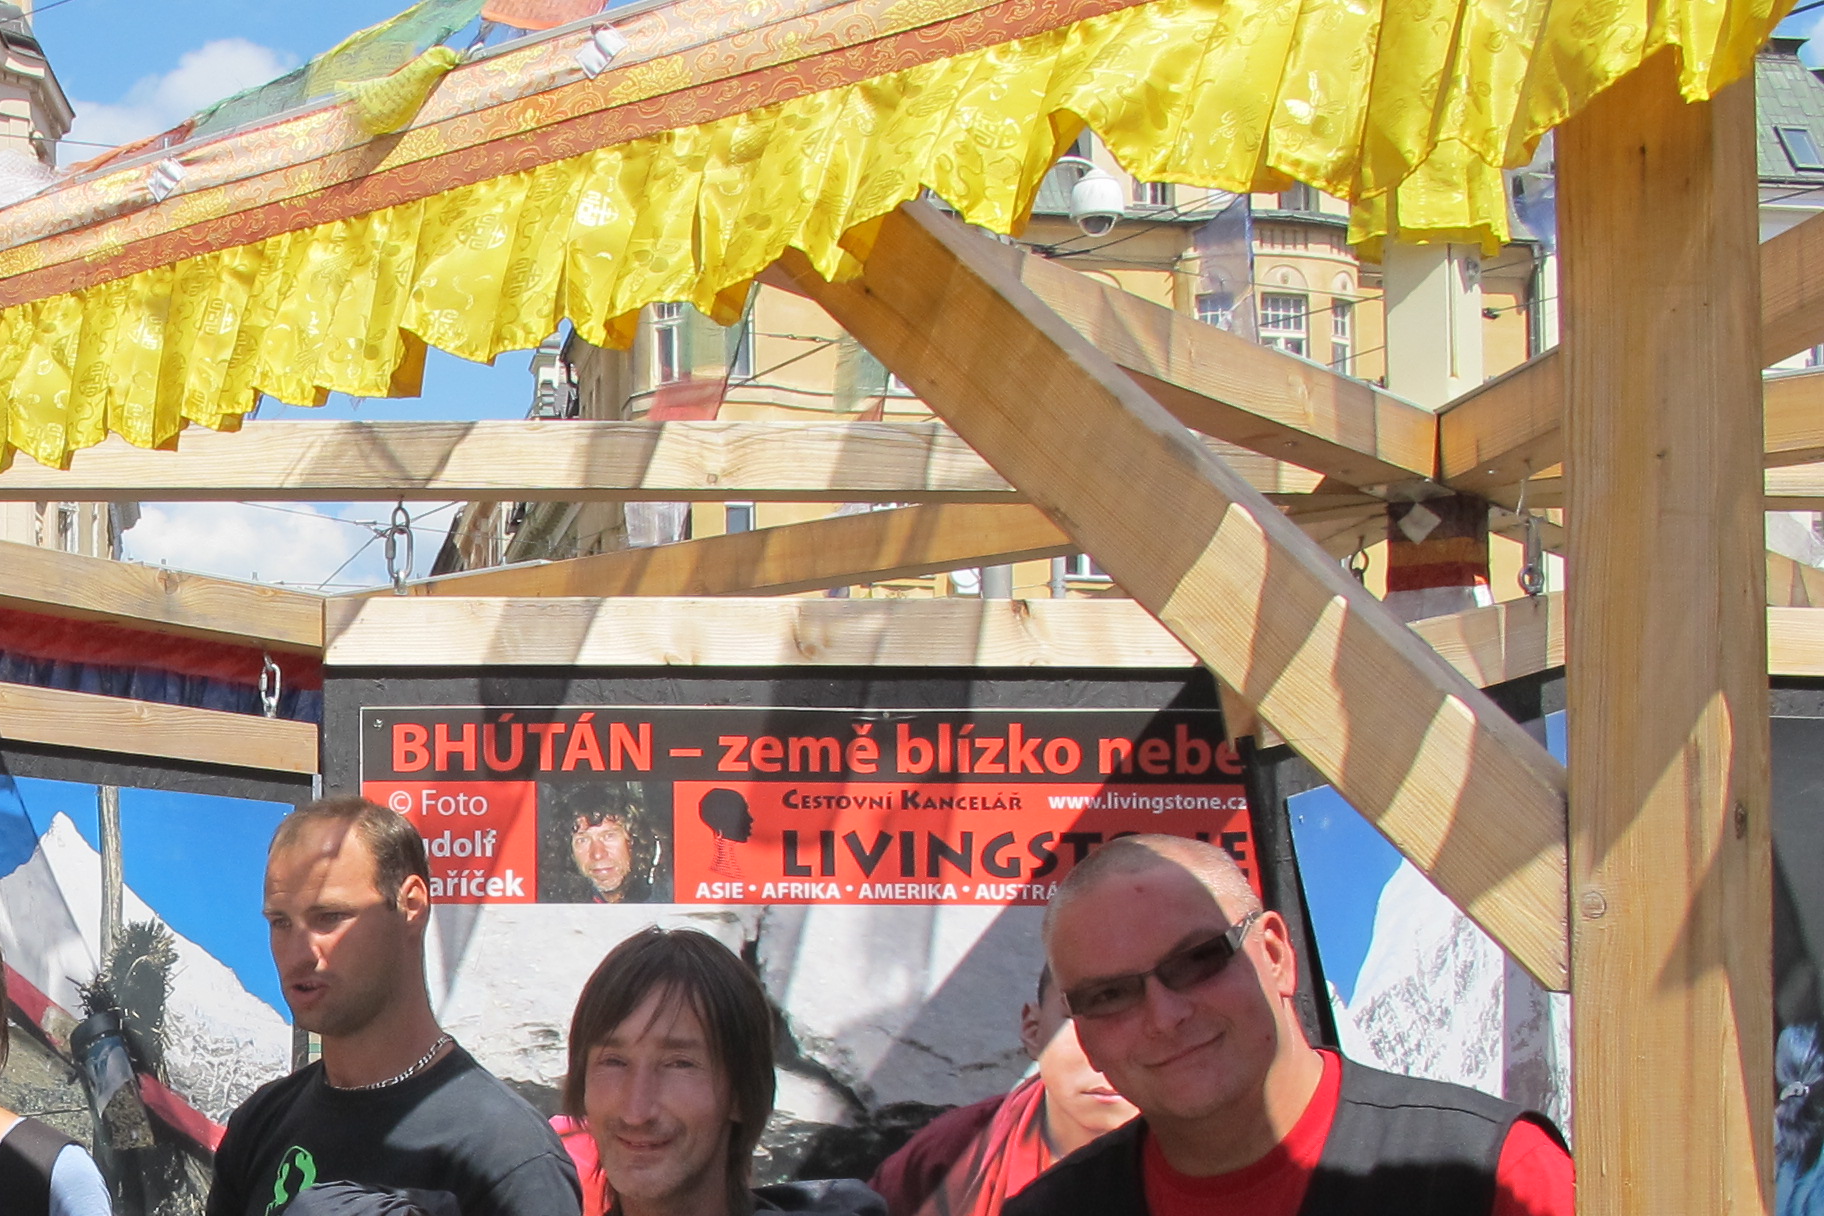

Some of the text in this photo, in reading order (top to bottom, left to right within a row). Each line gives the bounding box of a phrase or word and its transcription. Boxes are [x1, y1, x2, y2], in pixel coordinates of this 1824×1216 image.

[391, 711, 653, 773] BHÚTÁN
[717, 723, 879, 775] země
[896, 722, 1081, 775] blízko
[421, 789, 488, 816] Foto
[1048, 791, 1248, 815] www.livingstone.cz
[422, 828, 498, 858] dolf
[783, 829, 1250, 879] LIVINGSTE
[429, 868, 526, 898] aříček
[695, 880, 1059, 901] ASIE AFRIKA AMERIKA AUSTRÁ
